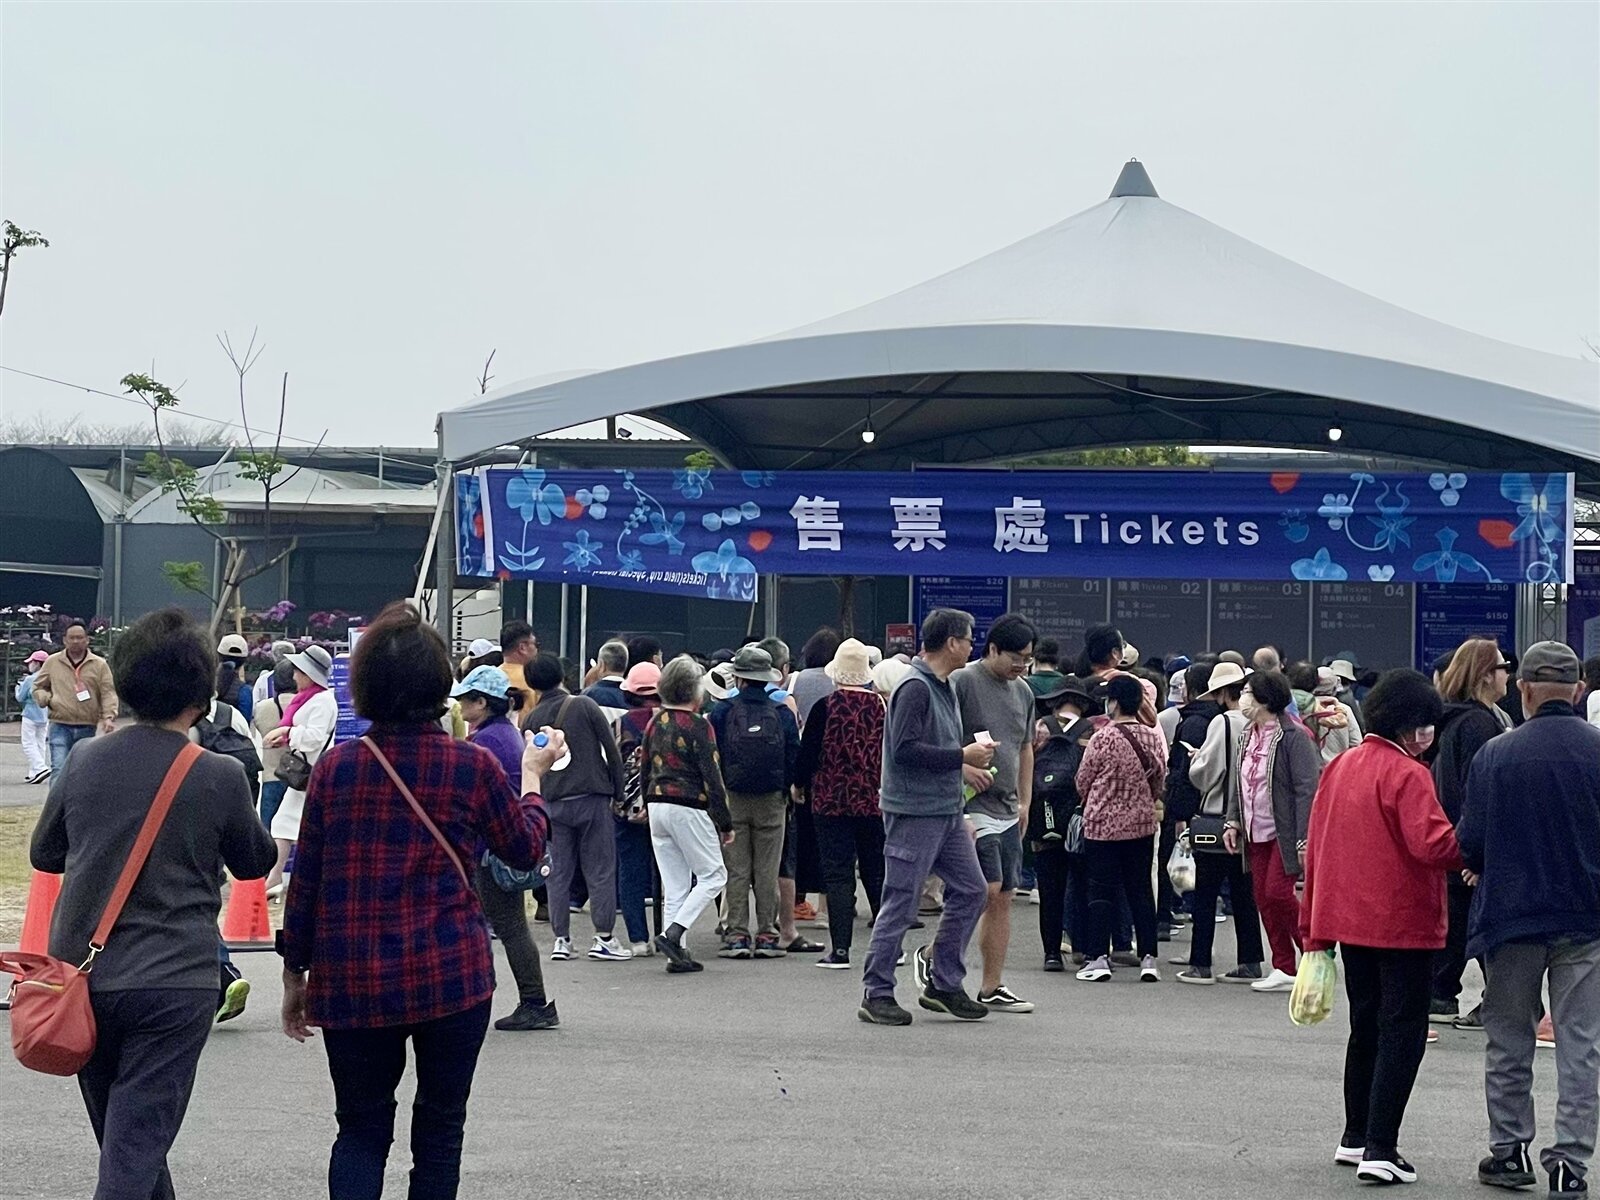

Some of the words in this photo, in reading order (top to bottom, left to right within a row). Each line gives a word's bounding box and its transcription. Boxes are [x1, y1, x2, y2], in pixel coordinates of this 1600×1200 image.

[789, 495, 1050, 553] 售票處
[1064, 513, 1260, 546] Tickets
[1083, 580, 1100, 592] 01
[1181, 582, 1201, 594] 02
[1282, 583, 1302, 595] 03
[1384, 584, 1405, 597] 04
[1486, 612, 1509, 620] $150
